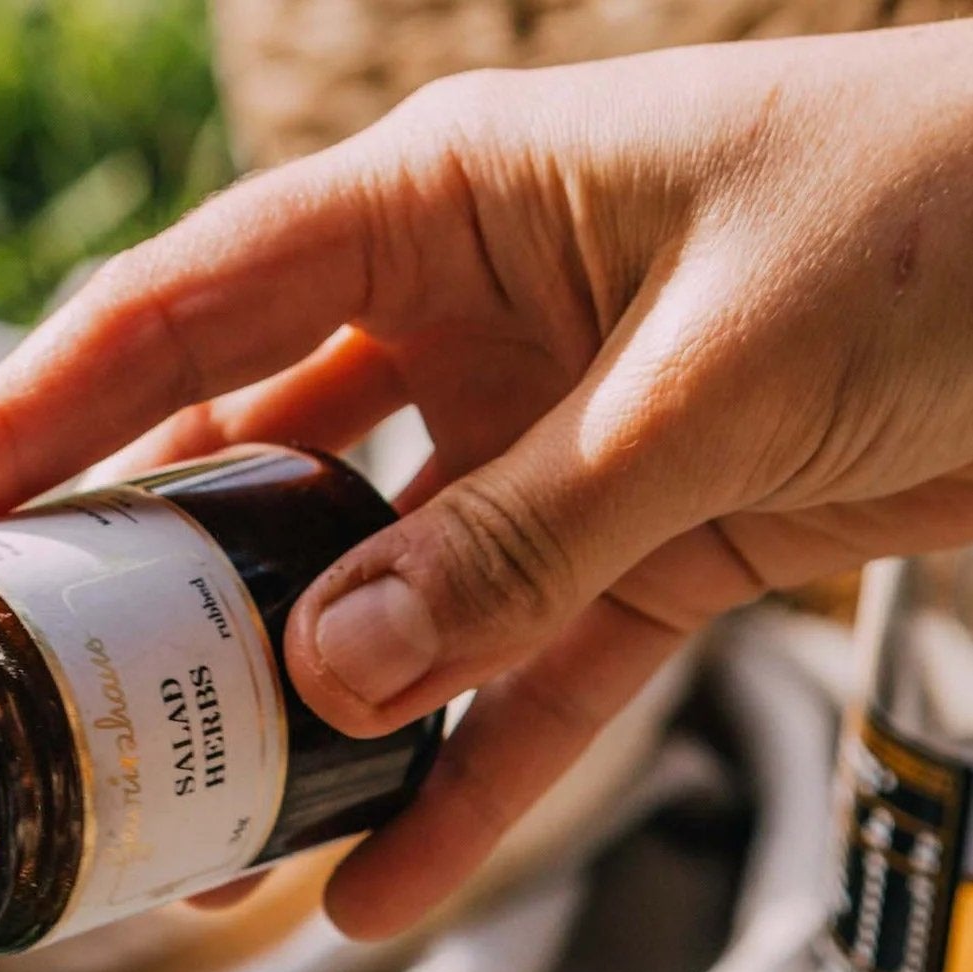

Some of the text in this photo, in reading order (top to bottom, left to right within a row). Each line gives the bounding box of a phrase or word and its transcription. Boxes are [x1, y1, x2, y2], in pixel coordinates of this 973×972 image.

[189, 576, 232, 640] rubbed
[160, 678, 196, 796] SALAD
[188, 665, 226, 788] HERBS
